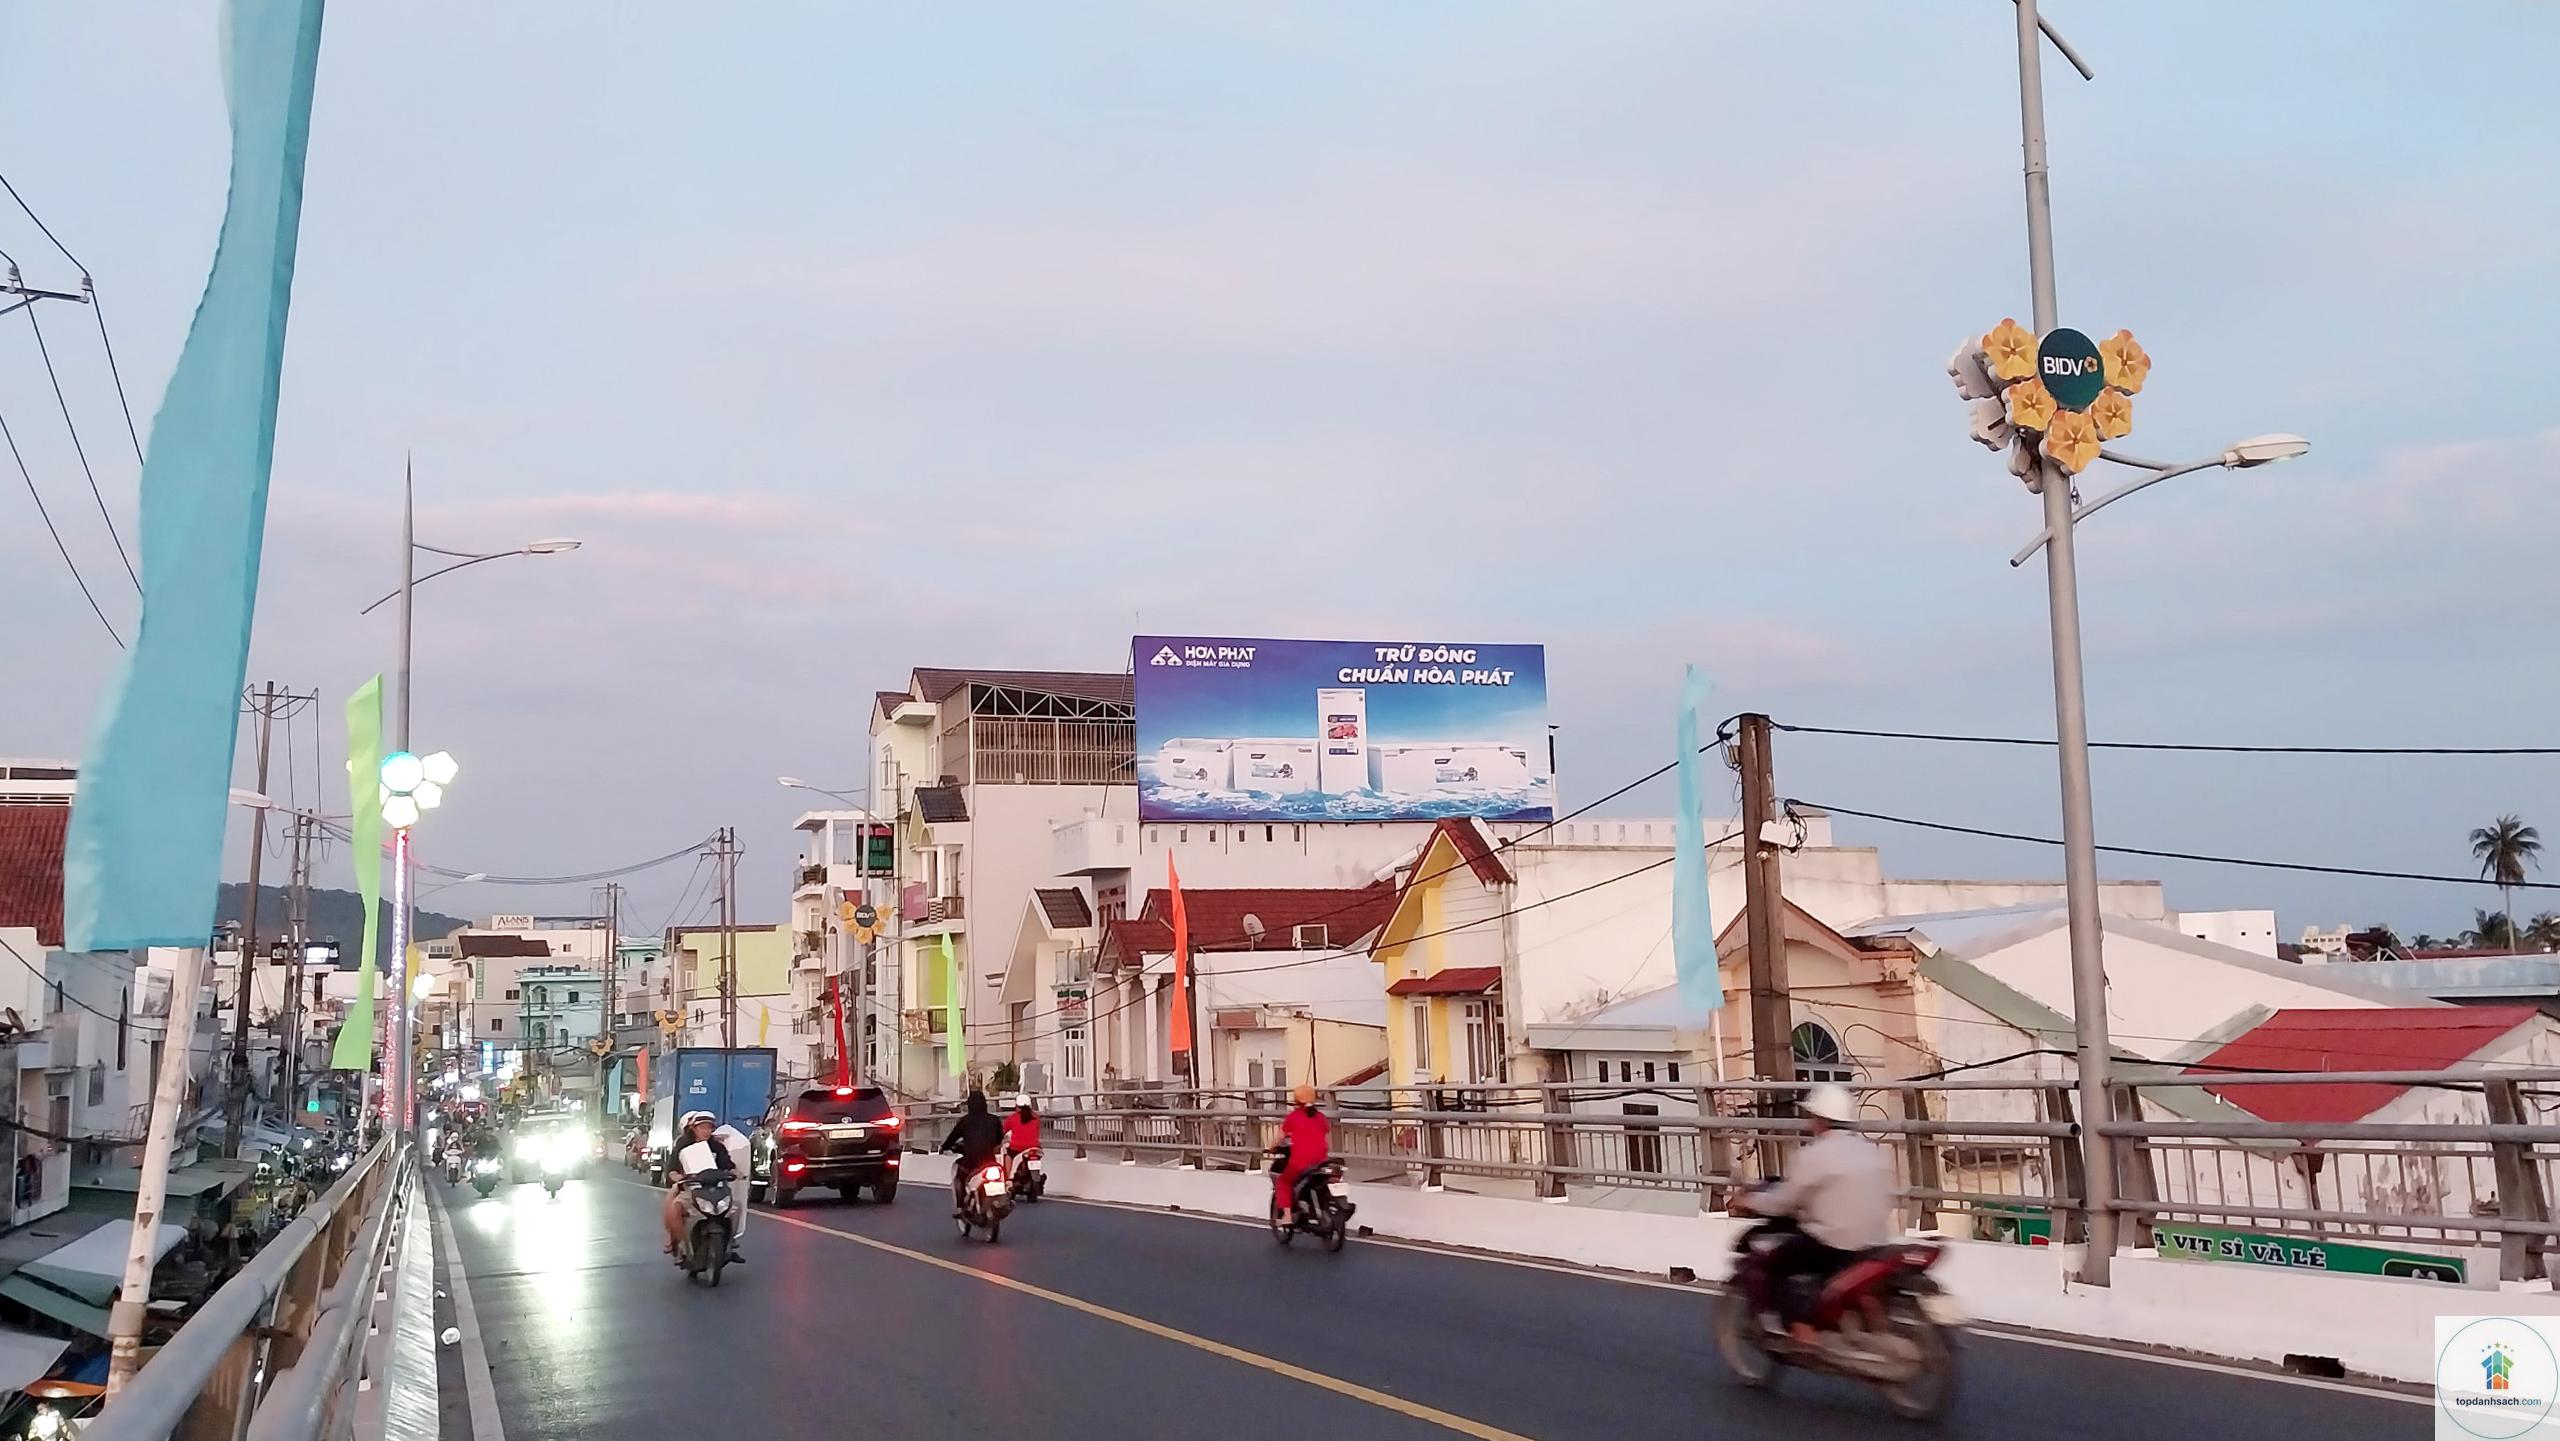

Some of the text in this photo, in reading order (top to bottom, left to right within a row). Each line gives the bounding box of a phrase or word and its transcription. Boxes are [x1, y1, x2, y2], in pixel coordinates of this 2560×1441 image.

[2043, 356, 2084, 376] BIDV
[1375, 645, 1476, 663] TRỮ ĐÔNG
[1338, 664, 1514, 685] CHUẨN HÒA PHÁT
[2173, 1233, 2212, 1253] VỊT
[2249, 1242, 2287, 1264] VÀ
